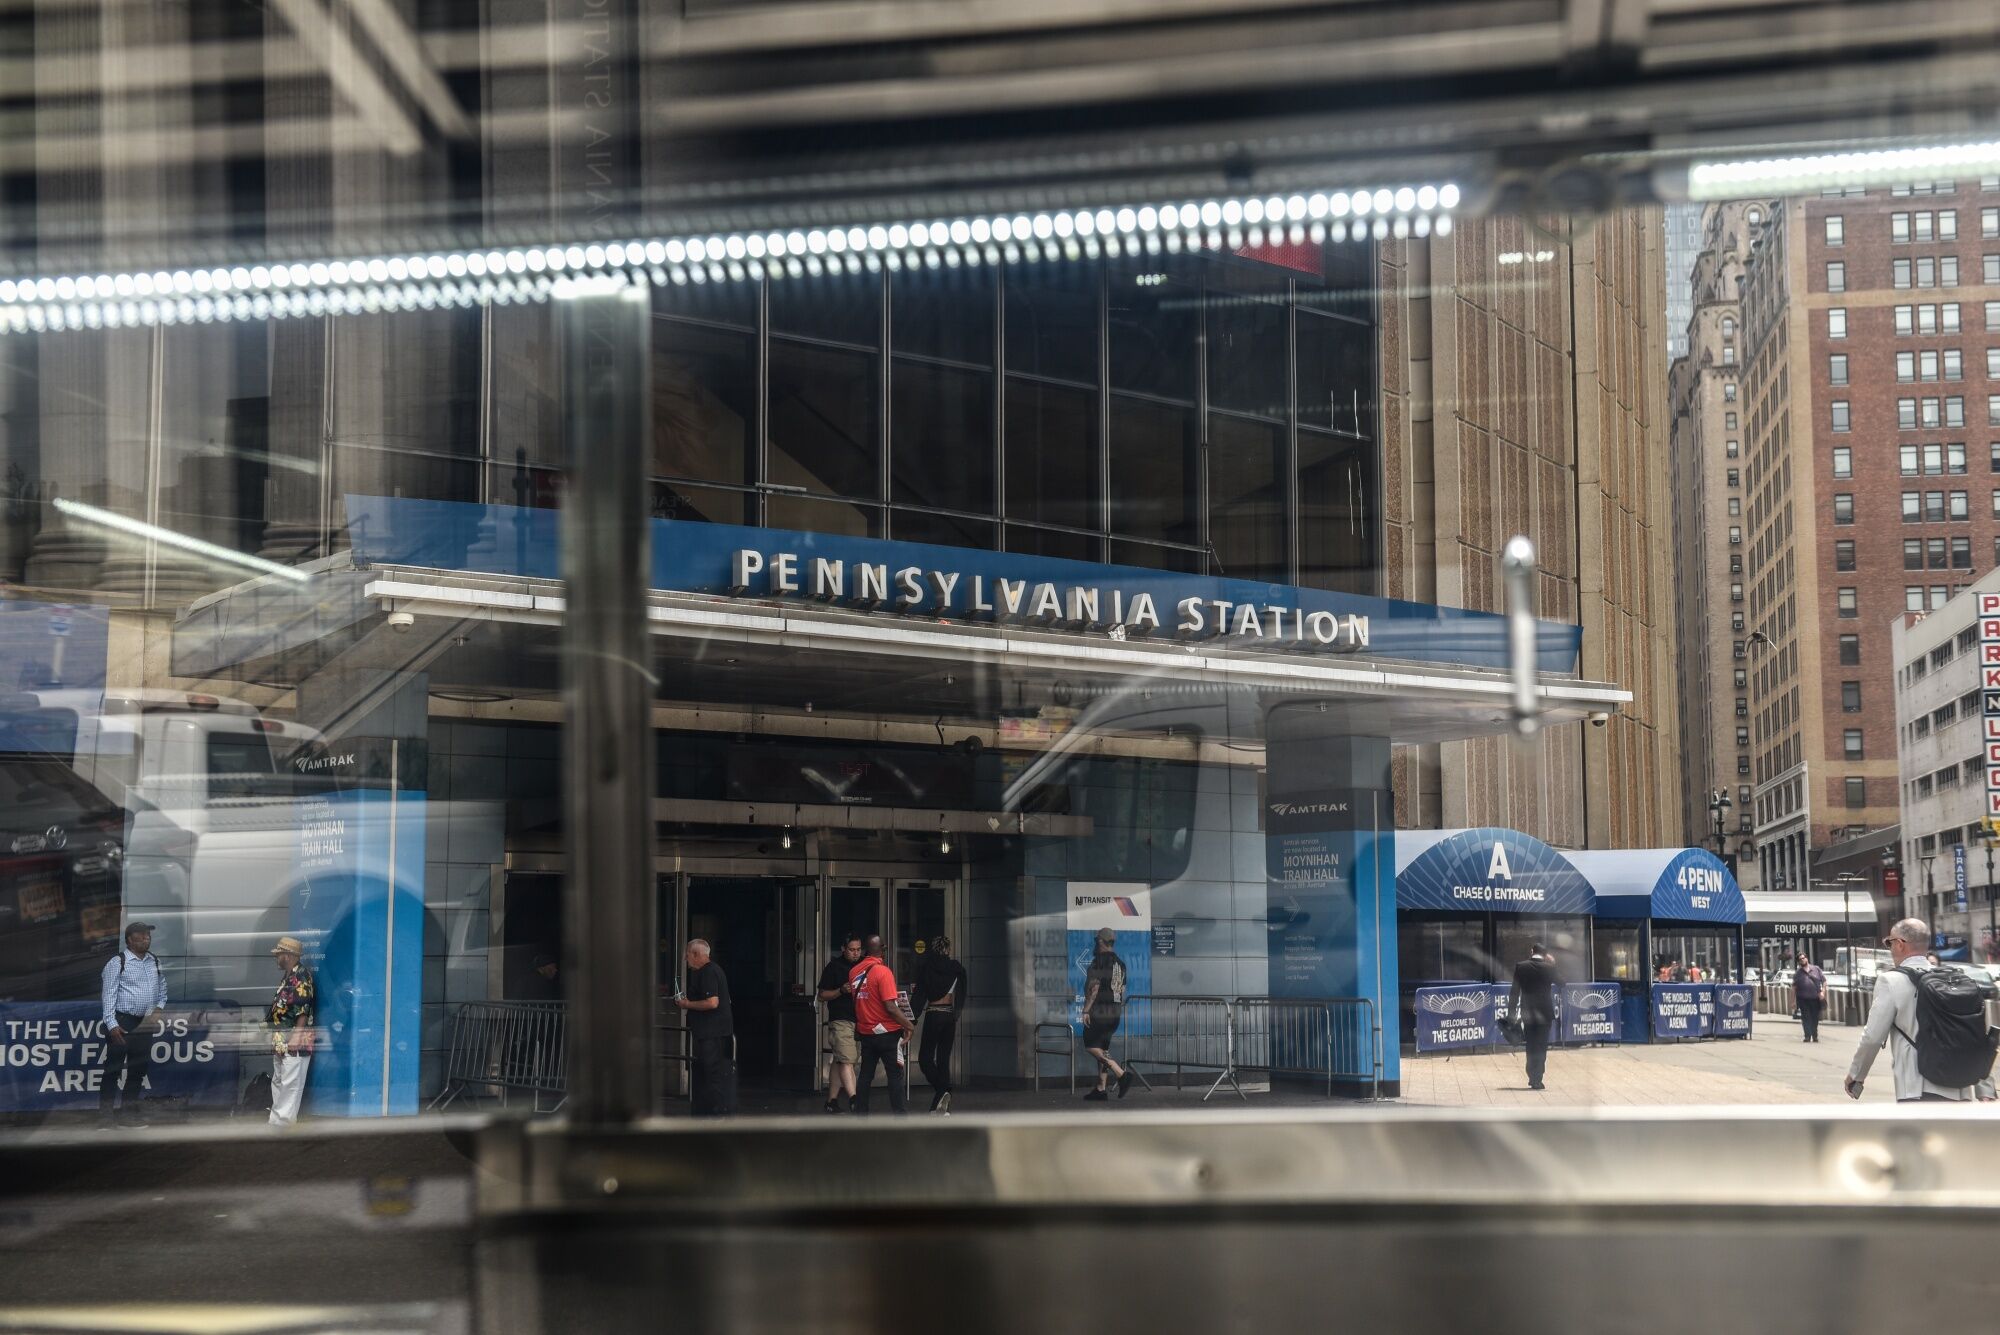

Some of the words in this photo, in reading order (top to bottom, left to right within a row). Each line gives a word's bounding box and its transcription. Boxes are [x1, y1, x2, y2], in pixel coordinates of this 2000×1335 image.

[733, 549, 1159, 628] PENNSYLVANIA
[1178, 597, 1369, 647] STATION
[1983, 596, 2000, 687] PARK
[308, 754, 355, 771] AMTRAK
[1288, 802, 1348, 815] AMTRAK
[302, 820, 344, 840] MOYNIHAN
[302, 842, 321, 857] TRAIN
[322, 839, 344, 854] HALL
[1283, 853, 1339, 868] MOYNIHAN
[1488, 842, 1512, 880] A
[1283, 869, 1311, 881] TRAIN
[1313, 868, 1339, 880] HALL
[1677, 866, 1687, 890] 4
[1688, 867, 1723, 893] PENN
[1955, 848, 1965, 899] TRACKS
[1084, 896, 1112, 904] TRANSIT
[1453, 886, 1483, 899] CHASE
[1494, 888, 1544, 900] ENTRANCE
[1691, 895, 1711, 909] WEST
[1774, 924, 1798, 934] FOUR
[1800, 924, 1826, 934] PENN
[1662, 992, 1672, 1003] THE
[1672, 992, 1692, 1003] WORLD'S
[1659, 1004, 1674, 1016] MOST
[1674, 1003, 1698, 1015] FAMOUS
[1441, 1018, 1468, 1028] WELCOME
[1468, 1017, 1476, 1026] TO
[1580, 1013, 1600, 1022] WELCOME
[1669, 1017, 1687, 1029] ARENA
[6, 1020, 60, 1040] THE
[68, 1018, 188, 1040] WOD'S
[1432, 1030, 1448, 1043] THE
[1449, 1027, 1485, 1042] GARDEN
[1573, 1023, 1587, 1035] THE
[1587, 1022, 1614, 1034] GARDEN
[0, 1044, 73, 1067] OST
[81, 1041, 215, 1065] FOUS
